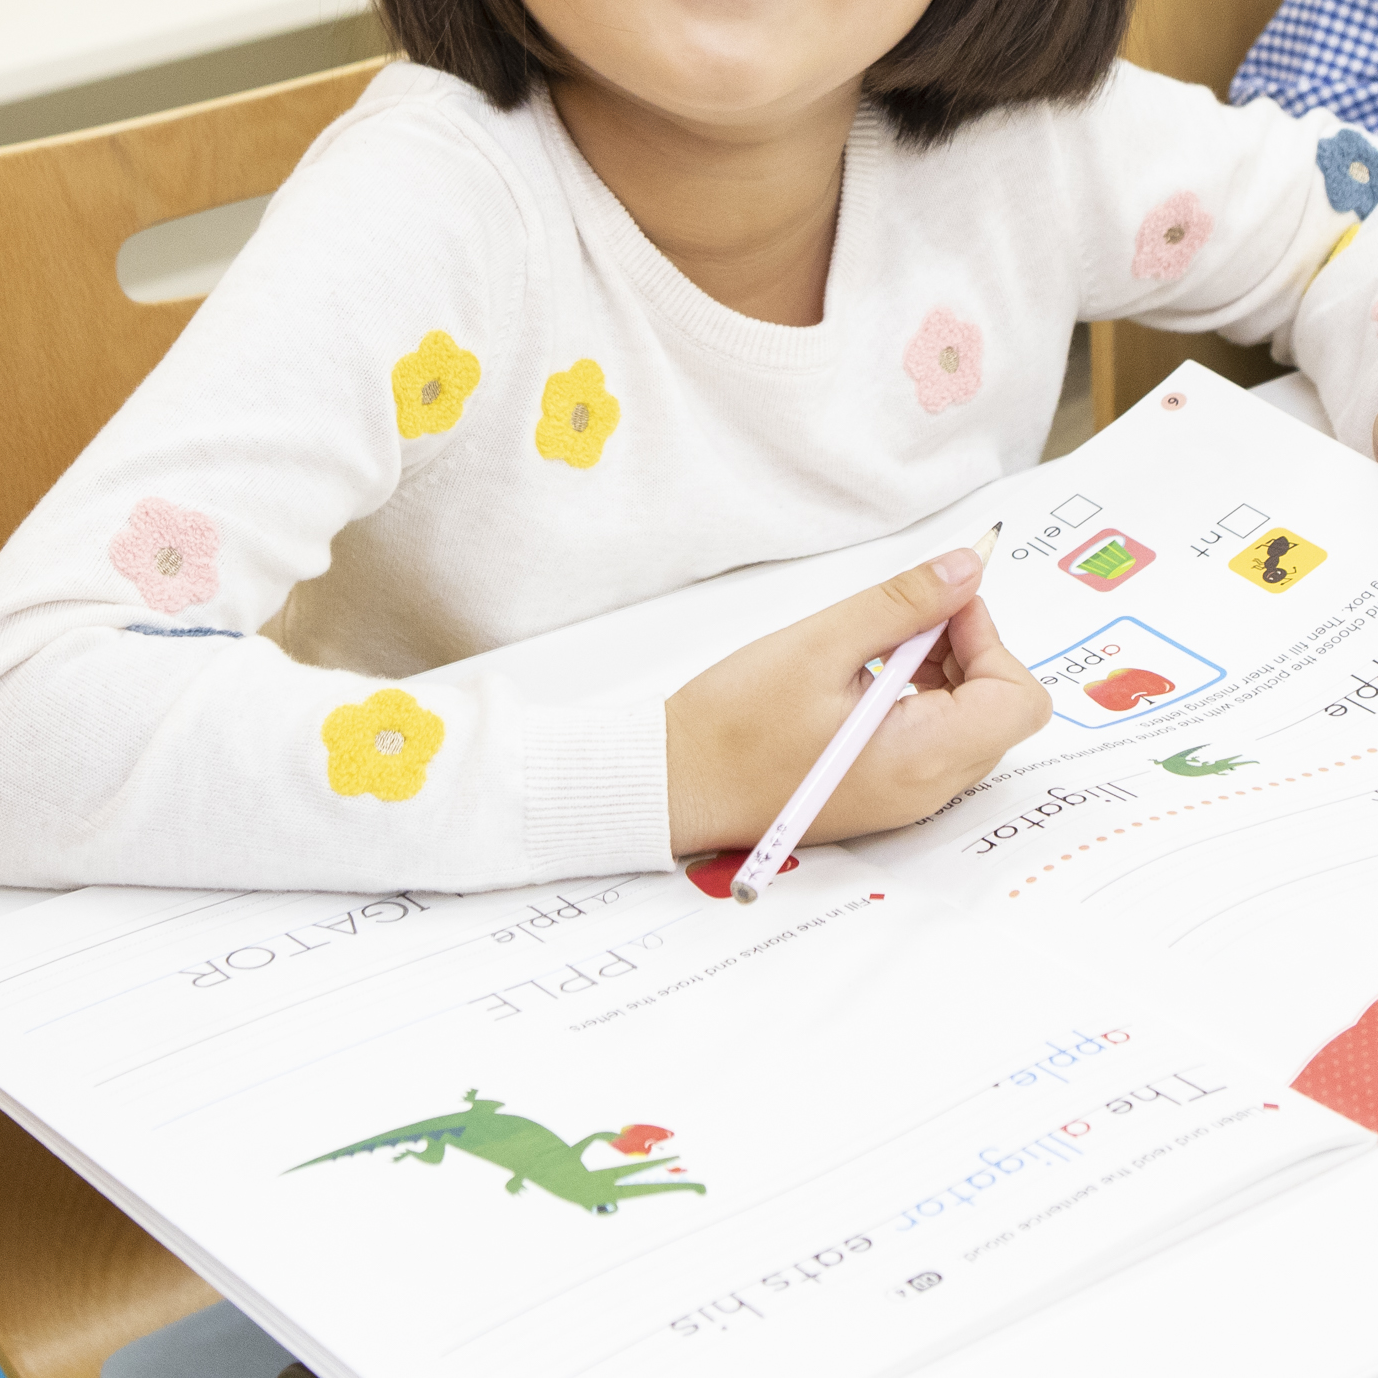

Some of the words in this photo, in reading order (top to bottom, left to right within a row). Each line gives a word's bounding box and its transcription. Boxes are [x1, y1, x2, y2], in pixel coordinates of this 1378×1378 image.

[1167, 396, 1181, 408] 6
[1009, 523, 1062, 564] ello
[1188, 529, 1223, 561] nt
[1341, 590, 1375, 612] box.
[1306, 616, 1346, 644] Then
[1315, 617, 1365, 656] choose
[1272, 653, 1292, 666] in
[1288, 641, 1309, 656] fill
[1039, 642, 1122, 689] apple
[1241, 663, 1275, 685] their
[1291, 655, 1318, 672] the
[1183, 683, 1240, 713] missing
[1234, 669, 1291, 705] pictures
[1208, 702, 1235, 719] with
[1135, 725, 1176, 743] same
[1177, 716, 1202, 730] the
[1060, 737, 1137, 762] beginning
[1013, 757, 1061, 776] sound
[991, 771, 1012, 785] as
[964, 781, 992, 798] the
[975, 782, 1139, 856] lligator
[825, 908, 845, 919] in
[844, 897, 871, 911] Fill
[797, 917, 826, 932] the
[739, 930, 798, 959] blanks
[704, 957, 737, 977] and
[657, 975, 704, 998] trace
[626, 995, 657, 1011] the
[991, 1029, 1131, 1091] apple.
[1105, 1072, 1228, 1116] The
[894, 1118, 1092, 1235] alligator
[760, 1234, 874, 1294] eats
[668, 1290, 765, 1338] his
